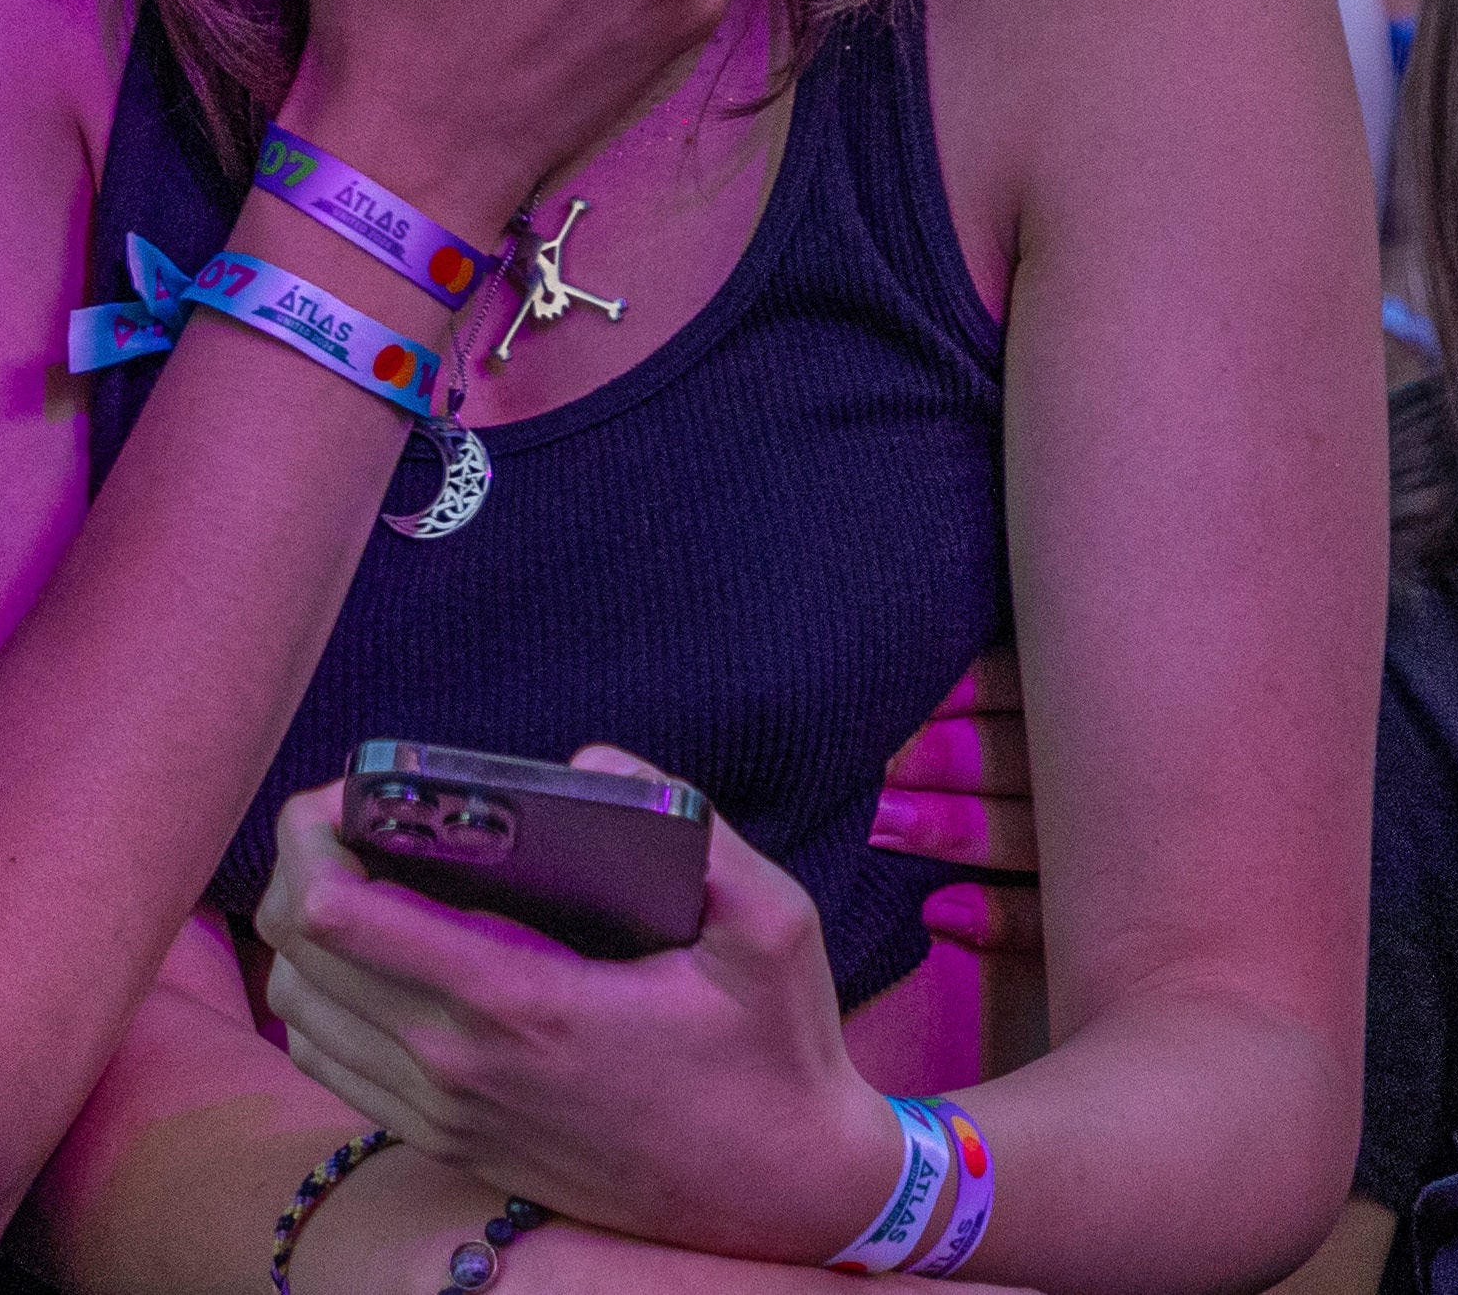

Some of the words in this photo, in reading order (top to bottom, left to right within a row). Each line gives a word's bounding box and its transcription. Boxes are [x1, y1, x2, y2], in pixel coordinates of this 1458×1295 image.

[258, 140, 319, 188] 07
[335, 180, 411, 241] ÁTLAS
[195, 258, 258, 298] 07
[276, 284, 354, 343] ÁTLAS
[888, 1157, 939, 1244] ÁTLAS
